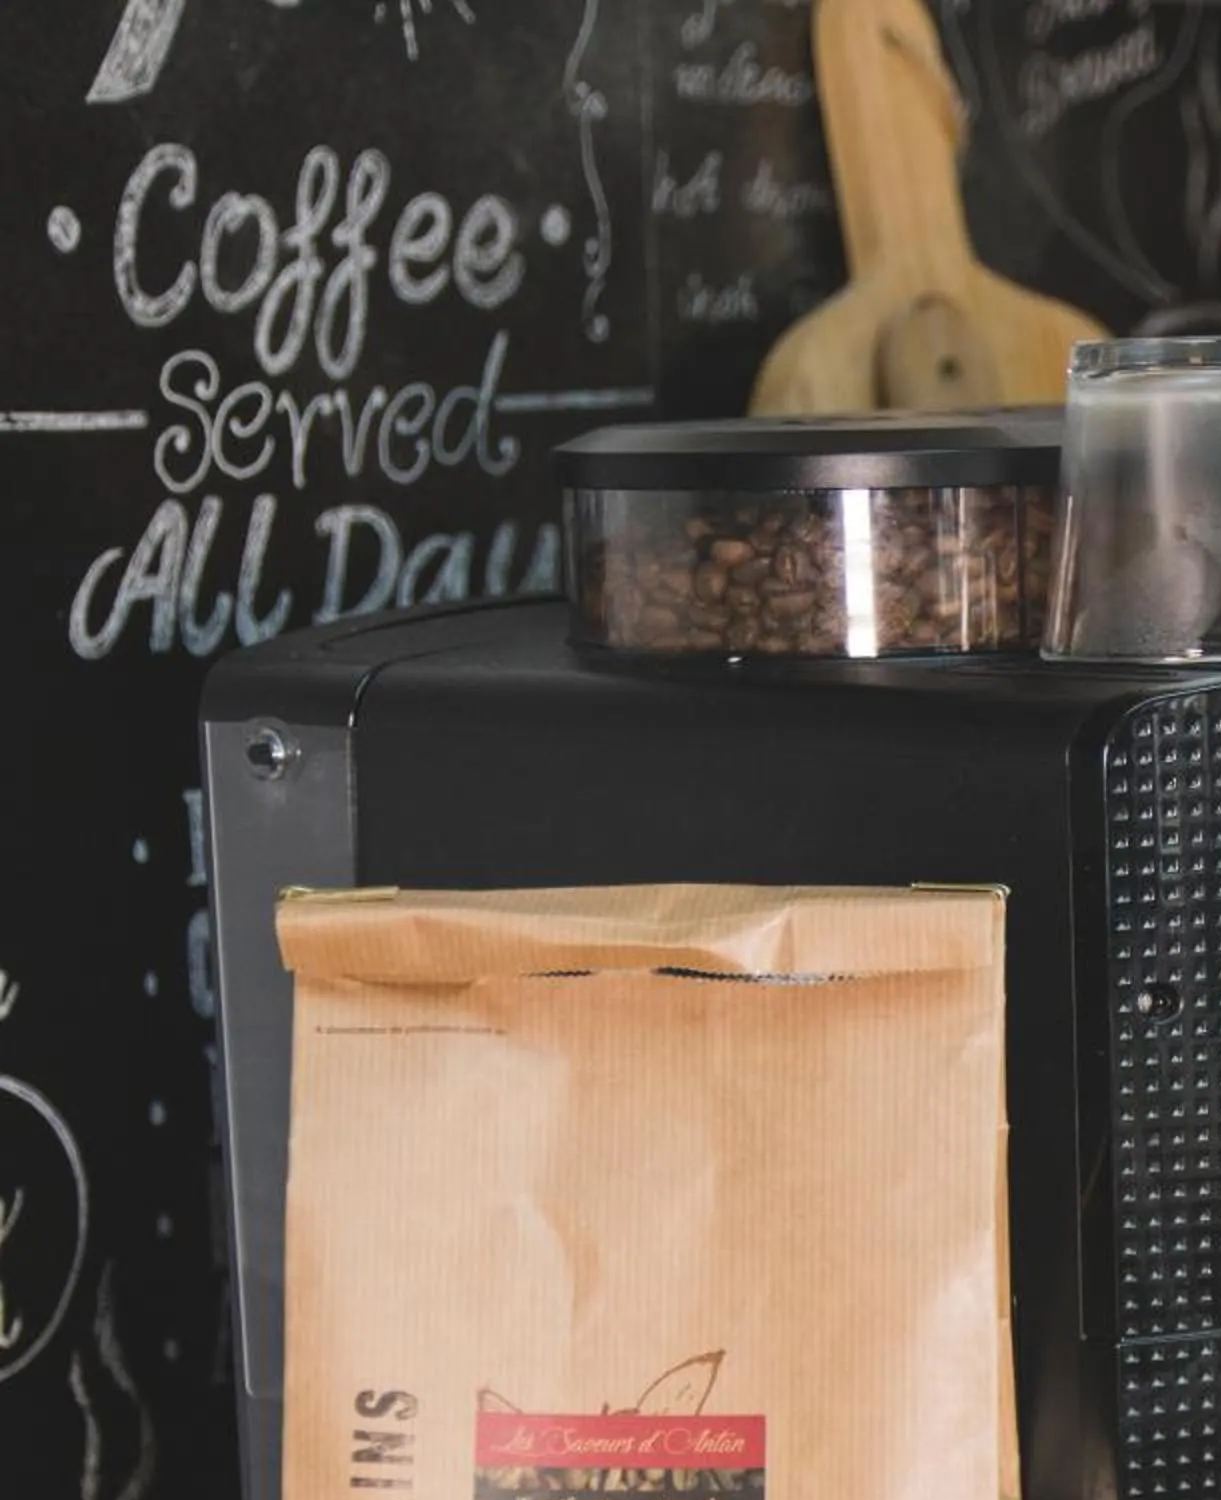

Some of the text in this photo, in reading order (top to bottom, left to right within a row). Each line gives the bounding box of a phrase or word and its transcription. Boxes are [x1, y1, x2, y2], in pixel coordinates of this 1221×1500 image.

[112, 142, 526, 380] Coffee
[152, 328, 520, 494] Served
[68, 494, 292, 660] All
